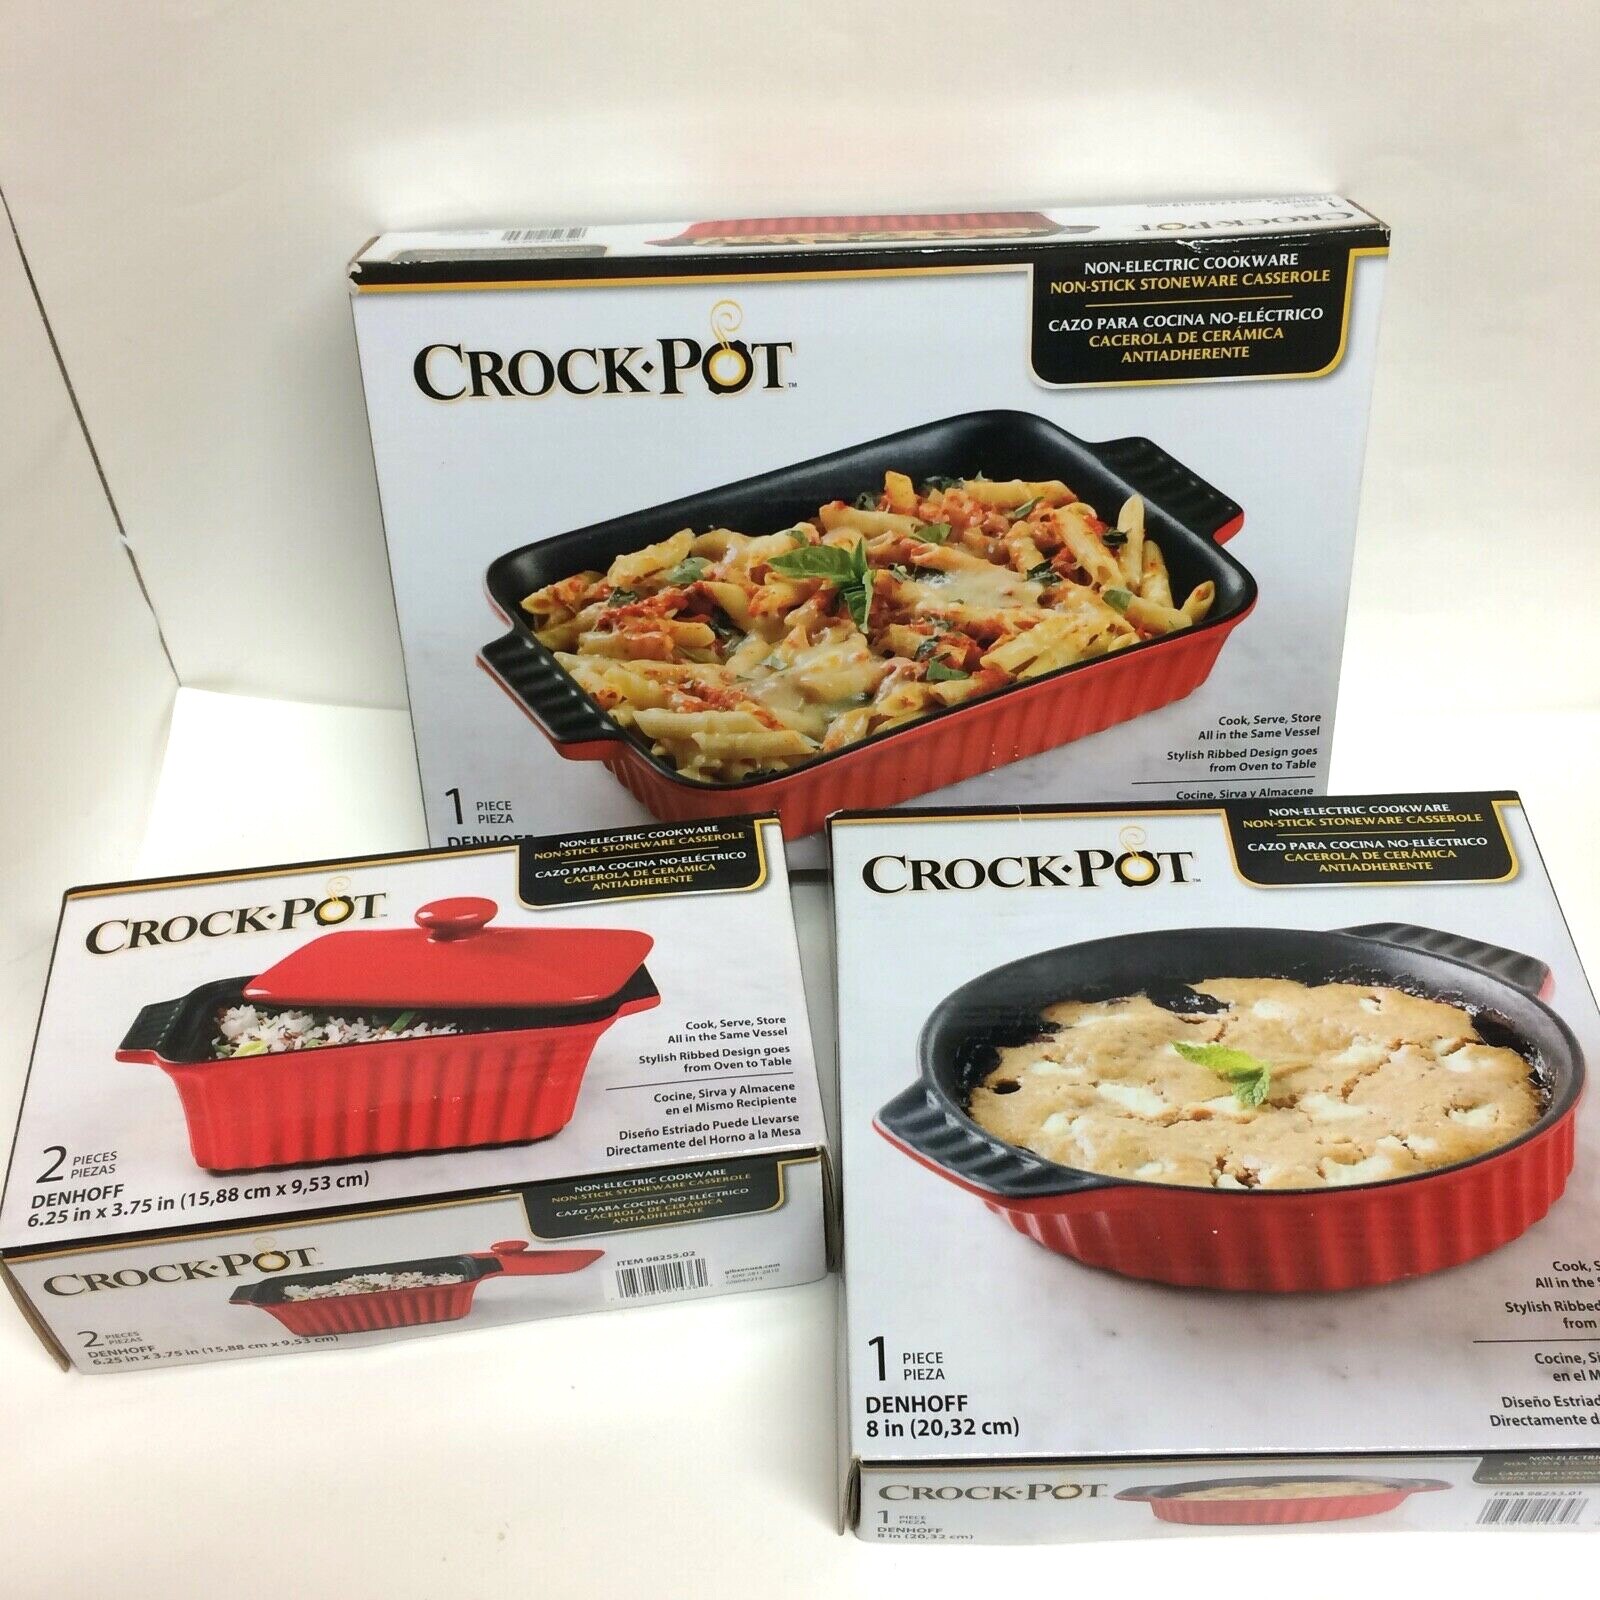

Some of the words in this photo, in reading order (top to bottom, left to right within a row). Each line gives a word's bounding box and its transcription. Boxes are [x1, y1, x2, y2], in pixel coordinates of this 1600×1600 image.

[1085, 258, 1199, 274] NON-ELECTRIC
[1204, 254, 1298, 269] COOKWARE
[1051, 280, 1136, 294] NON-STICK
[1140, 274, 1238, 290] STONEWARE
[1242, 270, 1330, 285] CASSEROLE
[1049, 319, 1092, 332] CAZO
[1097, 316, 1138, 329] PARA
[1144, 314, 1204, 328] COCINA
[1210, 307, 1323, 324] NO-ELÉCTRICO
[1089, 333, 1173, 347] CACEROLA
[1179, 332, 1197, 343] DE
[1202, 326, 1284, 342] CERÁMICA
[1122, 346, 1250, 363] ANTIADHERENTE
[1219, 716, 1250, 726] Cook,
[1254, 715, 1287, 724] Serve,
[1292, 714, 1321, 723] Store
[1199, 731, 1212, 740] All
[1217, 730, 1226, 739] in
[1230, 730, 1247, 739] the
[1251, 729, 1281, 738] Same
[1285, 727, 1320, 736] Vessel
[1167, 751, 1204, 762] Stylish
[1208, 749, 1246, 759] Ribbed
[1250, 748, 1288, 759] Design
[1291, 747, 1317, 757] goes
[1210, 763, 1235, 772] from
[1239, 762, 1268, 771] Oven
[1272, 762, 1282, 770] to
[1286, 760, 1316, 769] Table
[1177, 791, 1216, 800] Cocine,
[1220, 789, 1247, 798] Sirva
[1260, 787, 1313, 797] Almacene
[446, 788, 463, 824] 1
[477, 801, 512, 810] PIECE
[1269, 806, 1366, 817] NON-ELECTRIC
[1369, 804, 1450, 814] COOKWARE
[478, 814, 513, 824] PIEZA
[1243, 819, 1316, 828] NON-STICK
[1320, 816, 1403, 826] STONEWARE
[1407, 814, 1483, 823] CASSEROLE
[560, 834, 645, 848] NON-ELECTRIC
[648, 825, 719, 838] COOKWARE
[1248, 842, 1286, 852] CAZO
[1290, 841, 1324, 849] PARA
[1330, 840, 1384, 849] COCINA
[1388, 837, 1487, 848] NO-ELÉCTRICO
[534, 847, 599, 860] NON-STICK
[603, 838, 675, 853] STONEWARE
[678, 832, 745, 845] CASSEROLE
[1285, 852, 1359, 862] CACEROLA
[1362, 851, 1381, 860] DE
[1384, 849, 1457, 859] CERÁMICA
[535, 868, 569, 879] CAZO
[573, 864, 606, 874] PARA
[609, 860, 656, 871] COCINA
[660, 851, 747, 866] NO-ELÉCTRICO
[1319, 862, 1433, 873] ANTIADHERENTE
[564, 871, 629, 884] CACEROLA
[634, 868, 649, 876] DE
[653, 864, 716, 875] CERÁMICA
[592, 875, 693, 891] ANTIADHERENTE
[686, 1019, 718, 1030] Cook,
[720, 1018, 754, 1028] Serve,
[757, 1016, 786, 1025] Store
[668, 1035, 682, 1044] All
[685, 1034, 696, 1043] in
[699, 1032, 716, 1041] the
[720, 1030, 750, 1039] Same
[753, 1027, 787, 1038] Vessel
[639, 1053, 676, 1065] Stylish
[680, 1049, 719, 1060] Ribbed
[723, 1048, 761, 1058] Design
[764, 1045, 790, 1055] goes
[684, 1063, 711, 1073] from
[714, 1061, 744, 1070] Oven
[747, 1059, 758, 1068] to
[760, 1057, 792, 1066] Table
[654, 1091, 695, 1103] Cocine,
[699, 1089, 727, 1098] Sirva
[730, 1089, 736, 1097] y
[740, 1082, 795, 1094] Almacene
[666, 1107, 679, 1116] en
[683, 1104, 692, 1113] el
[696, 1101, 734, 1112] Mismo
[737, 1095, 797, 1108] Recipiente
[619, 1127, 659, 1140] Diseño
[663, 1121, 709, 1136] Estriado
[713, 1119, 749, 1131] Puede
[752, 1114, 799, 1125] Llevarse
[606, 1139, 685, 1157] Directamente
[689, 1137, 706, 1147] del
[710, 1132, 745, 1145] Horno
[758, 1130, 768, 1140] la
[771, 1127, 800, 1137] Mesa
[36, 1146, 67, 1184] 2
[73, 1151, 118, 1166] PIECES
[70, 1163, 116, 1179] PIEZAS
[552, 1191, 613, 1203] NON-STICK
[616, 1183, 685, 1195] STONEWARE
[689, 1174, 751, 1186] CASSEROLE
[575, 1177, 657, 1193] NON-ELECTRIC
[659, 1169, 726, 1182] COOKWARE
[28, 1211, 68, 1228] 6.25
[73, 1207, 91, 1222] in
[96, 1208, 107, 1219] x
[112, 1199, 152, 1218] 3.75
[157, 1196, 174, 1210] in
[181, 1188, 239, 1211] (15,88
[244, 1185, 271, 1201] cm
[275, 1185, 286, 1196] x
[292, 1176, 331, 1196] 9,53
[337, 1170, 370, 1188] cm)
[31, 1184, 124, 1209] DENHOFF
[556, 1208, 587, 1218] CAZO
[591, 1204, 620, 1213] PARA
[623, 1199, 666, 1208] COCINA
[584, 1208, 644, 1221] CACEROLA
[617, 1258, 643, 1267] ITEM
[646, 1251, 695, 1262] 98255.02
[1553, 1261, 1591, 1272] Cook,
[1536, 1277, 1553, 1288] All
[1556, 1278, 1568, 1287] in
[1572, 1278, 1594, 1287] the
[1505, 1302, 1551, 1315] Stylish
[1563, 1317, 1596, 1329] from
[77, 1331, 104, 1348] 2
[88, 1345, 155, 1358] DENHOFF
[868, 1336, 886, 1381] 1
[903, 1352, 943, 1364] PIECE
[1535, 1353, 1585, 1365] Cocine,
[904, 1368, 944, 1380] PIEZA
[1553, 1372, 1570, 1381] en
[1574, 1370, 1586, 1381] el
[866, 1395, 968, 1414] DENHOFF
[1502, 1396, 1551, 1408] Diseño
[866, 1420, 878, 1438] 8
[885, 1420, 903, 1436] in
[910, 1418, 976, 1438] (20,32
[982, 1416, 1020, 1437] cm)
[1490, 1414, 1587, 1426] Directamente
[877, 1511, 888, 1524] 1
